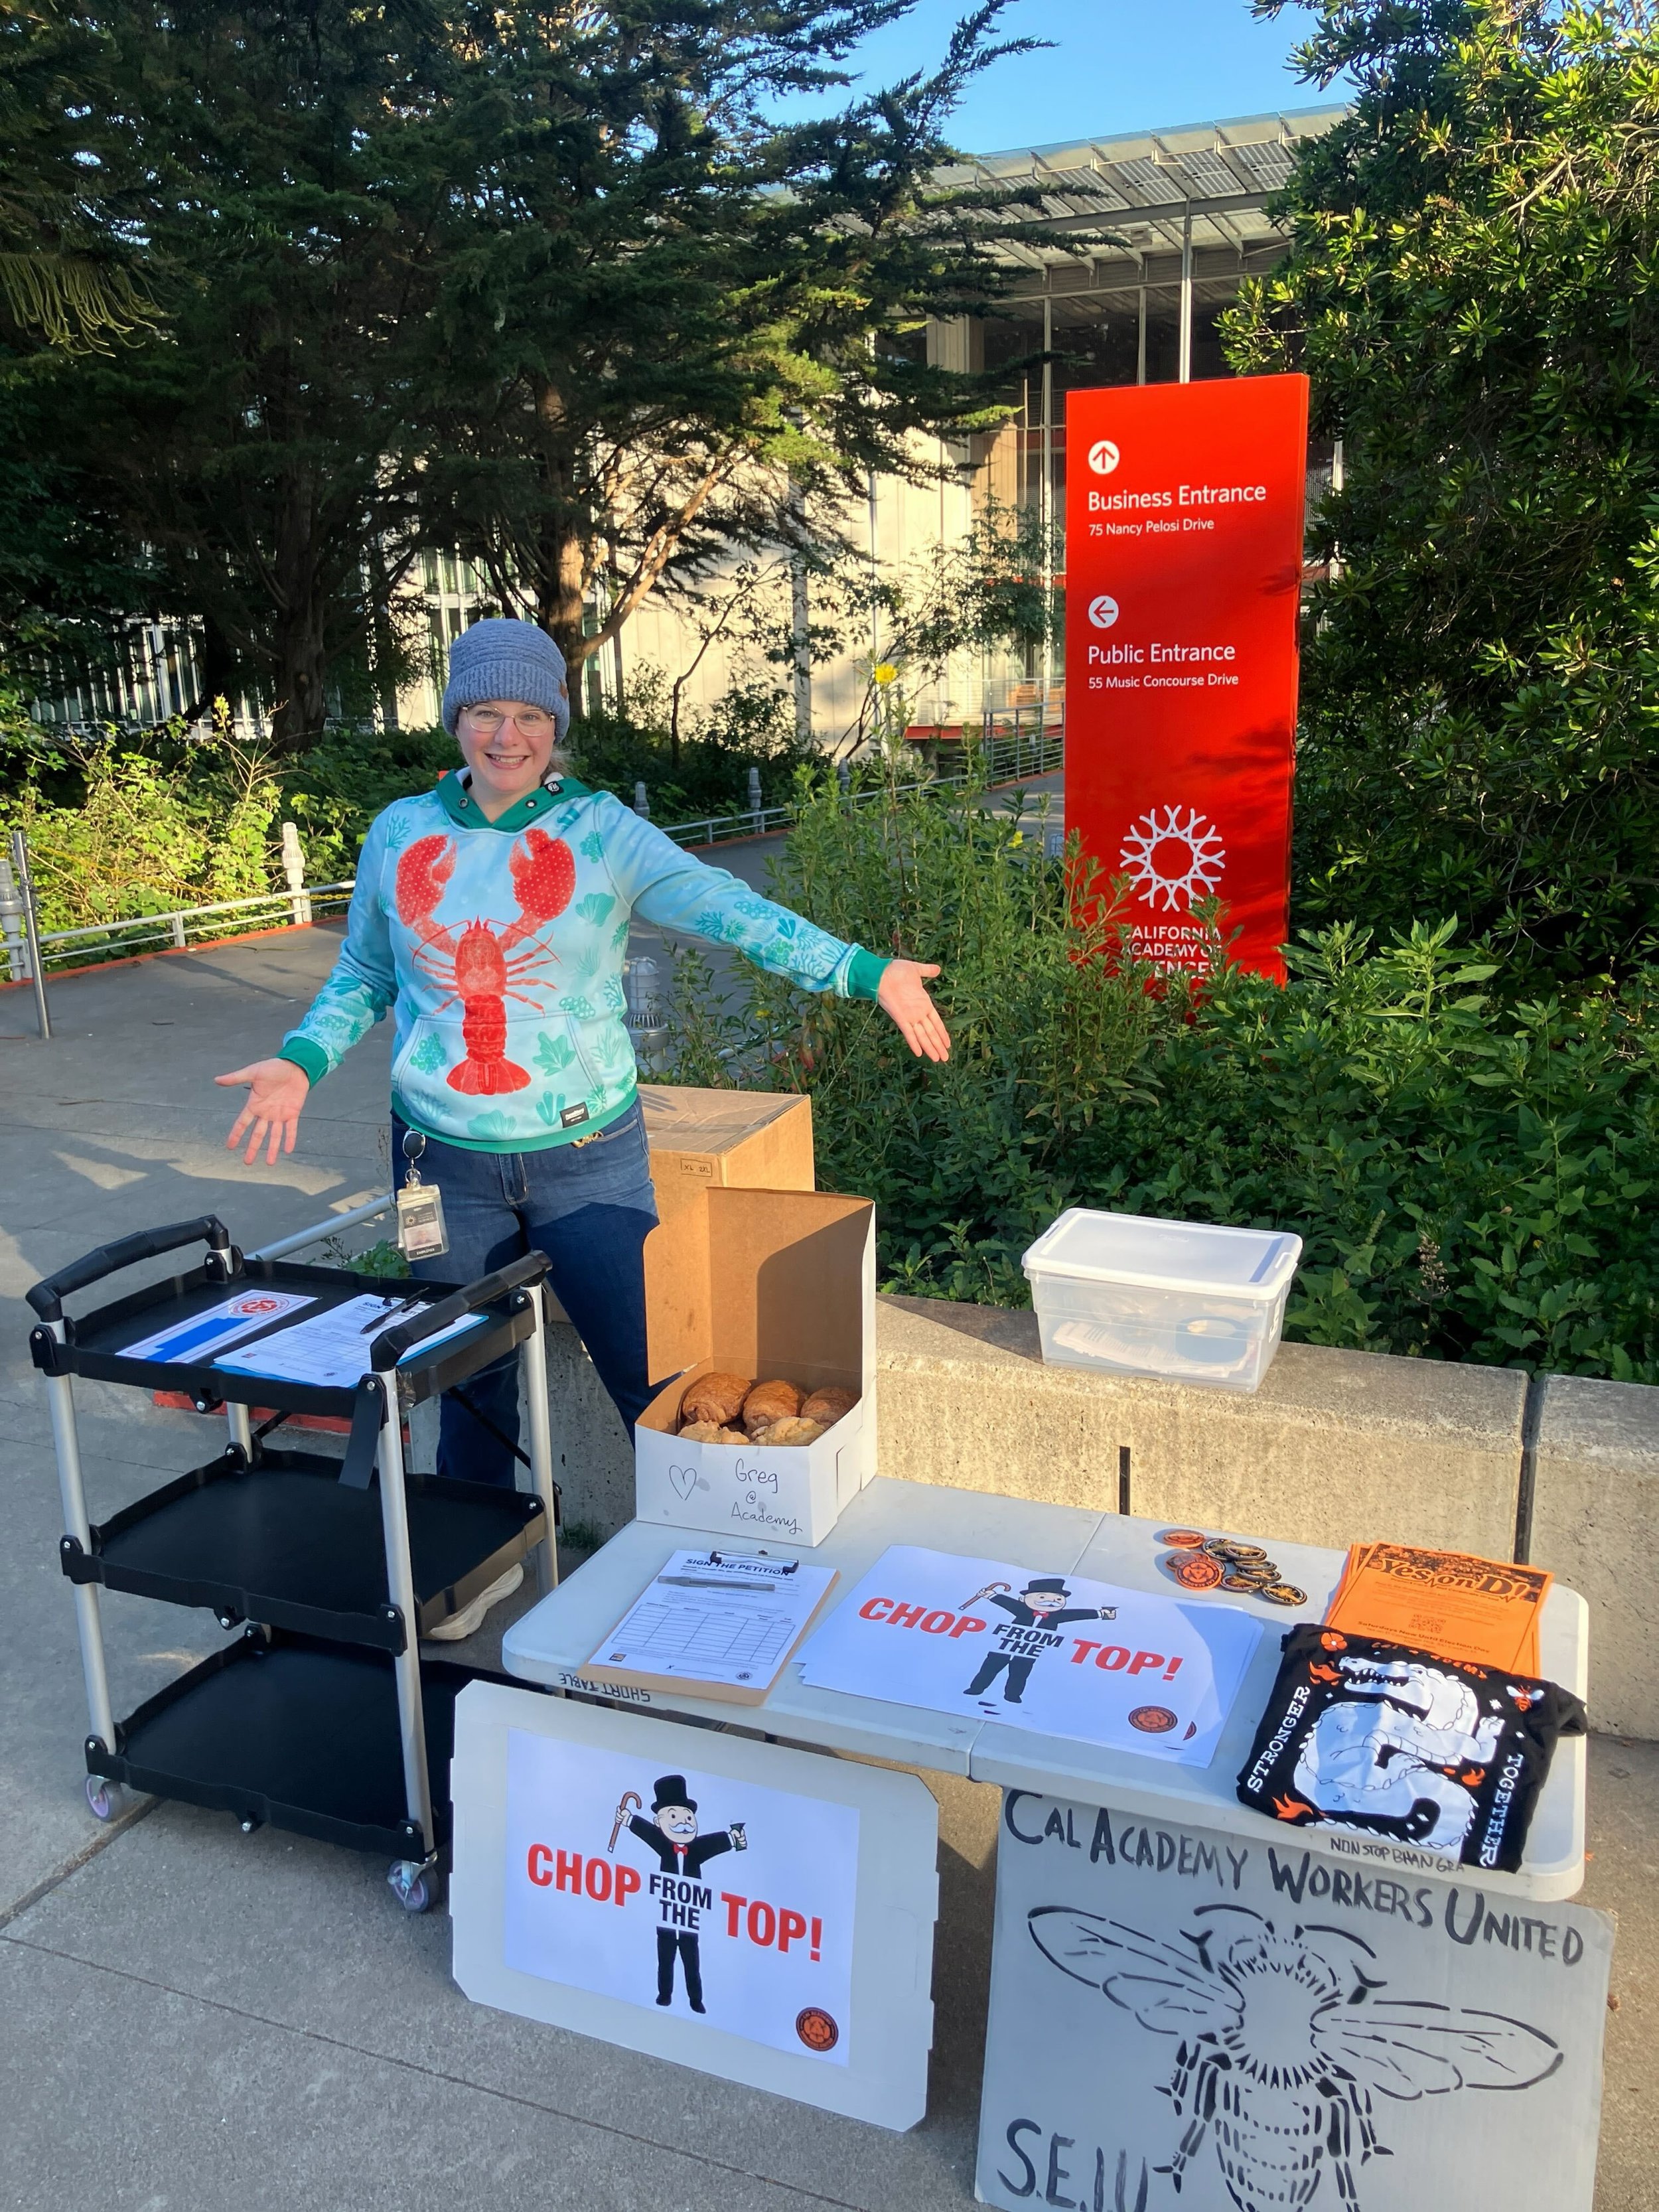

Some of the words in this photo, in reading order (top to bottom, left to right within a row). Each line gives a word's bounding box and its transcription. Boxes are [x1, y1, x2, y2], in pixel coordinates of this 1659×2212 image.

[1088, 489, 1173, 511] Business
[1179, 484, 1266, 505] Entrance
[1088, 524, 1103, 536] 75
[1106, 522, 1143, 536] Nancy
[1146, 519, 1179, 533] Pelosi
[1183, 518, 1214, 531] Drive
[1088, 644, 1144, 664] Public
[1151, 643, 1236, 663] Entrance
[1088, 677, 1102, 689] 55
[1106, 676, 1140, 688] Music
[1143, 674, 1204, 687] Concourse
[1208, 673, 1239, 686] Drive
[1126, 926, 1221, 940] ALIFORNIA
[735, 1458, 778, 1493] Greg
[746, 1491, 757, 1504] @
[731, 1502, 802, 1534] Academy
[686, 1558, 712, 1567] SIGN
[738, 1564, 788, 1576] PETITION
[1380, 1559, 1431, 1581] Yes
[1437, 1574, 1473, 1589] on
[1476, 1574, 1527, 1598] D!
[859, 1596, 987, 1639] CHOP
[992, 1623, 1064, 1648] FROM
[1070, 1638, 1184, 1682] TOP!
[998, 1637, 1045, 1658] THE
[558, 1672, 599, 1692] TABLE
[601, 1683, 650, 1702] SHORT
[1247, 1686, 1311, 1793] STRONGER
[1480, 1753, 1524, 1867] TOGETHER
[1331, 1837, 1360, 1855] NON
[1362, 1844, 1390, 1860] STOP
[1005, 1789, 1082, 1848] CAL
[1090, 1807, 1248, 1890] ACADEMY
[1268, 1846, 1433, 1928] WORKERS
[1445, 1887, 1583, 1966] UNITED
[527, 1843, 642, 1907] CHOP
[649, 1873, 712, 1911] FROM
[721, 1891, 823, 1962] TOP!
[659, 1898, 700, 1931] THE
